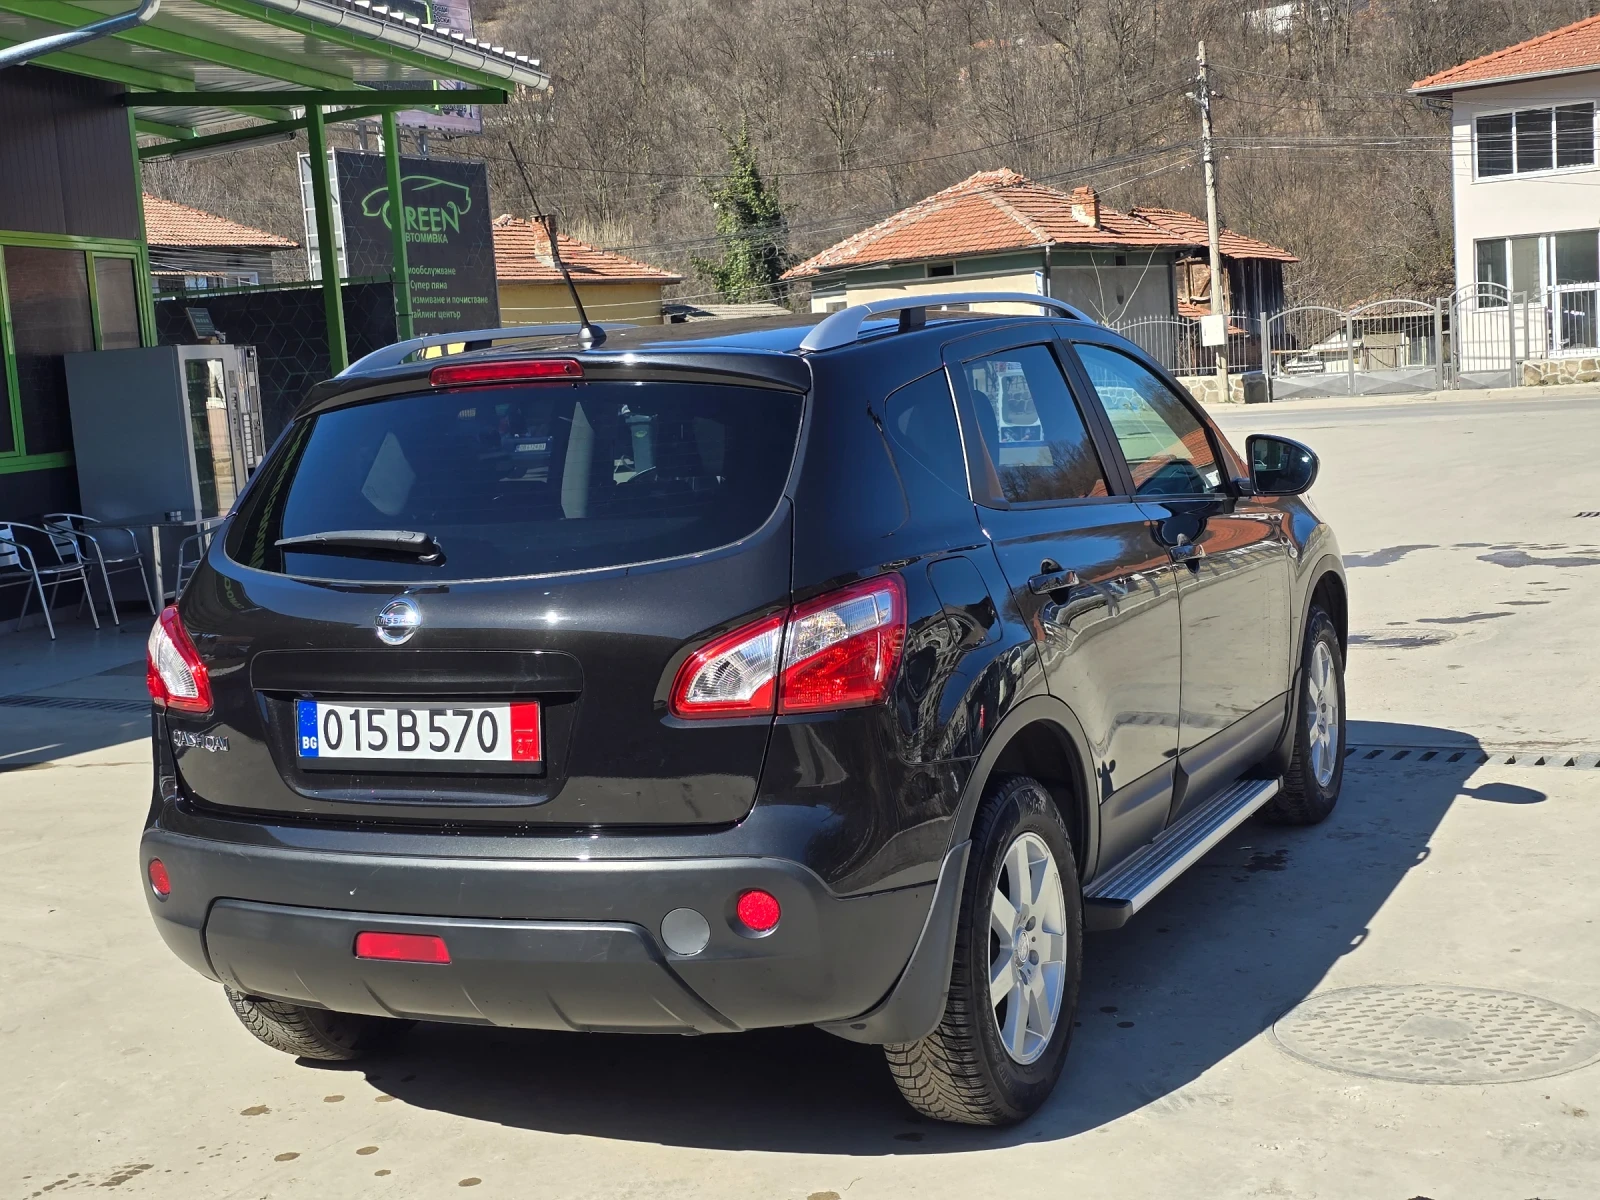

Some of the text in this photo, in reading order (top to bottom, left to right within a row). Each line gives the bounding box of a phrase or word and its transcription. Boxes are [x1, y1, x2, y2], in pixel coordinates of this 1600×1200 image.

[405, 232, 449, 244] ВТОМИВКА
[410, 280, 448, 291] Супер пяна
[452, 296, 489, 304] почистване
[438, 311, 461, 320] център
[173, 729, 229, 752] QASHQAI
[302, 736, 317, 750] BG
